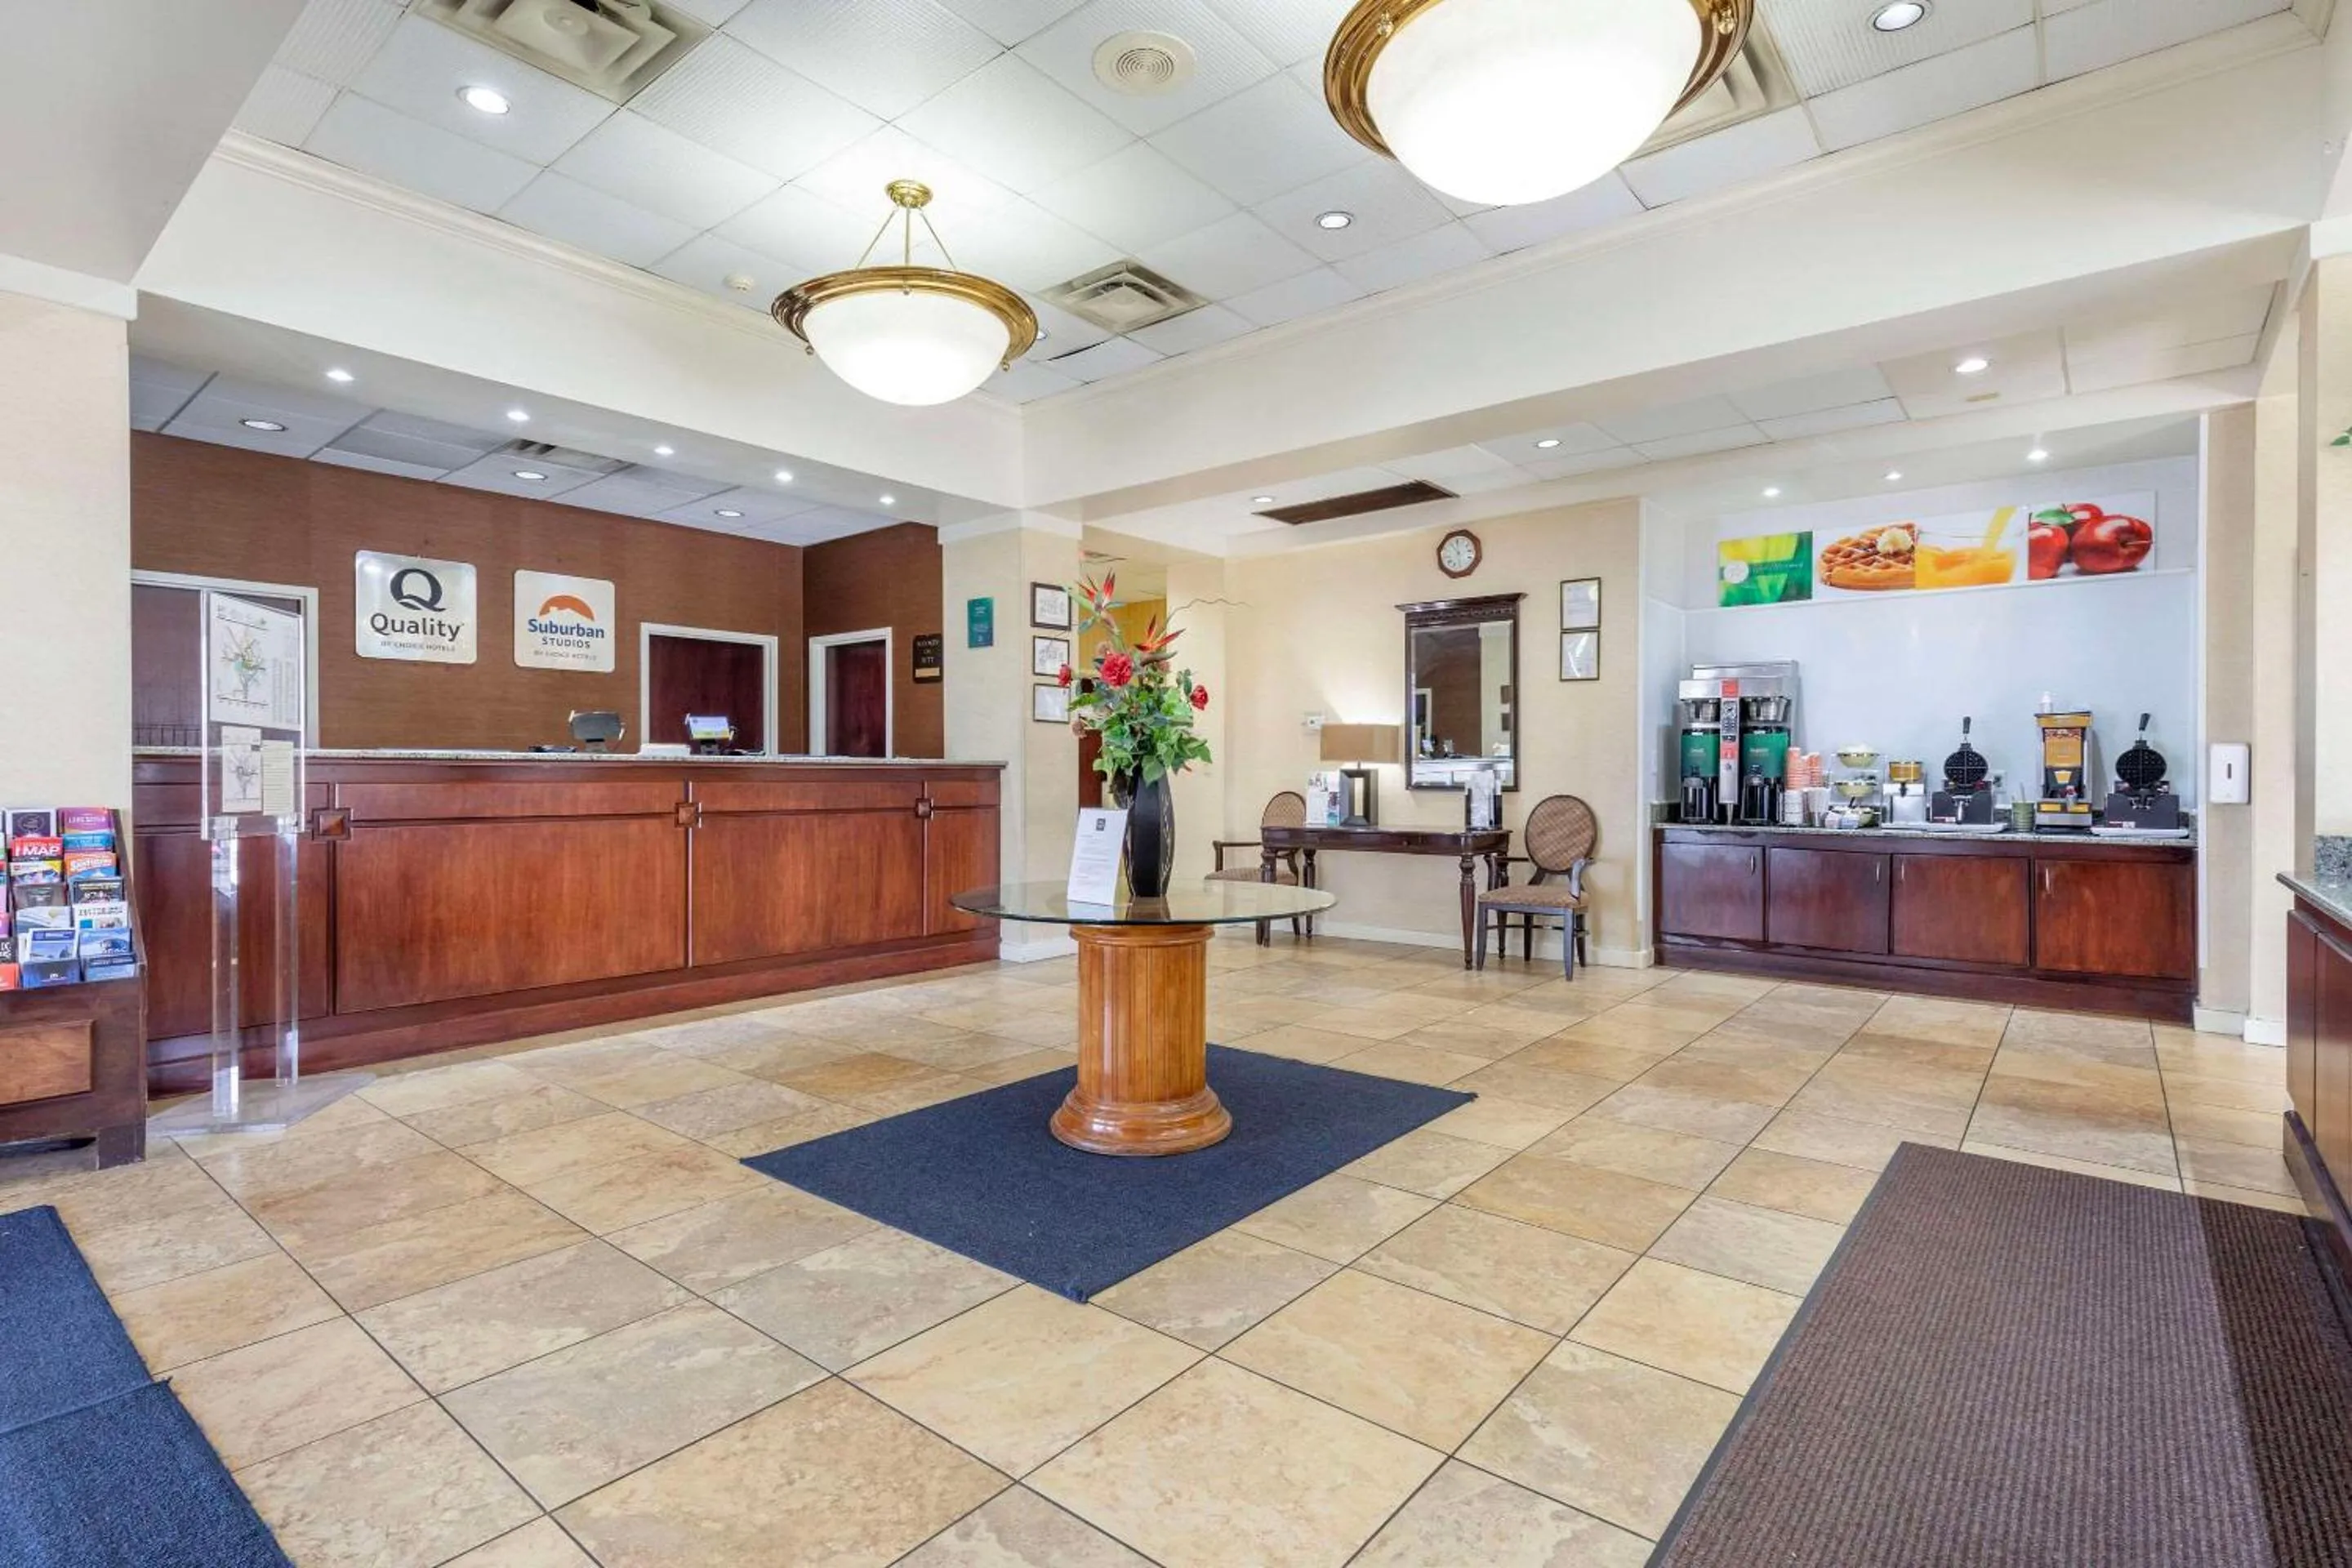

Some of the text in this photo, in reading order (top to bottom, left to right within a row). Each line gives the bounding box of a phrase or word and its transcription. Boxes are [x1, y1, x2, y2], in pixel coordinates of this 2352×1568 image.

[390, 568, 447, 612] Q
[370, 612, 460, 642] Quality
[528, 618, 605, 639] Suburban
[541, 637, 591, 649] STUDIOS
